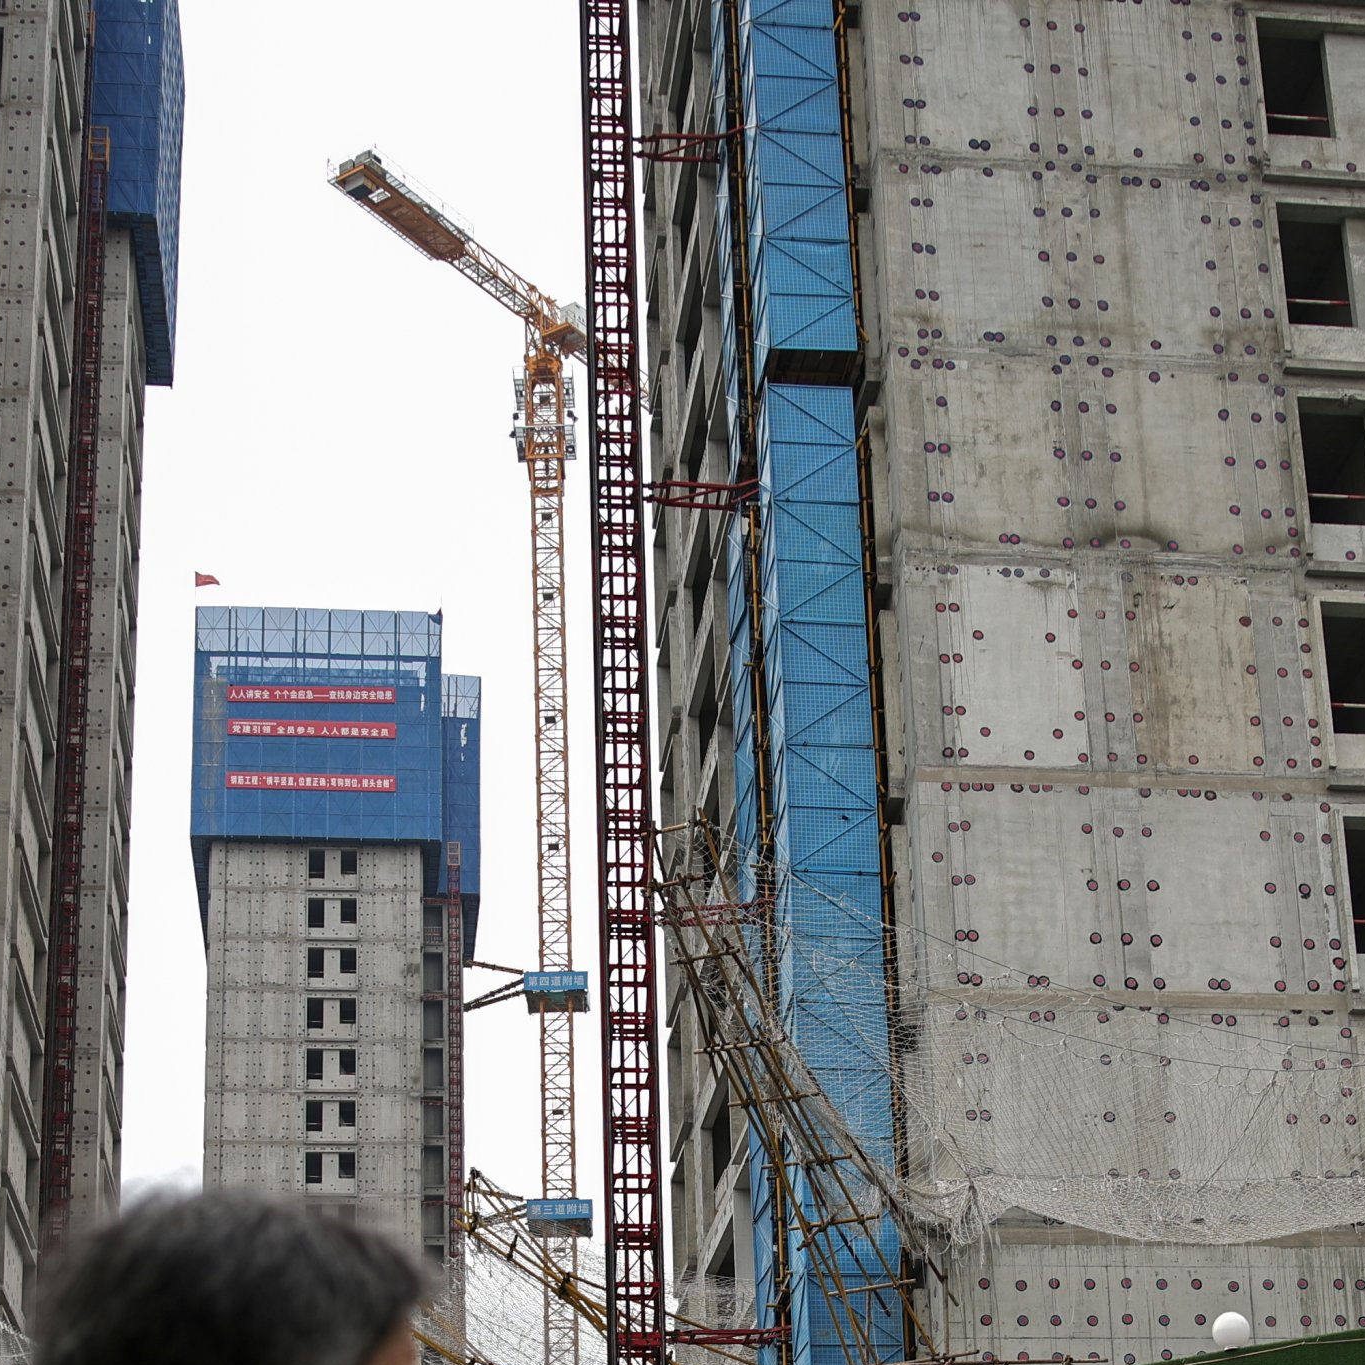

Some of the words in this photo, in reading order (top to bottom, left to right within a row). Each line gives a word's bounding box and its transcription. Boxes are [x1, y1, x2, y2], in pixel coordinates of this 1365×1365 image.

[230, 689, 270, 699] 人人讲安全
[232, 725, 271, 733] 党建引领
[277, 726, 315, 735] 全员参与
[321, 726, 389, 737] 人人都是安全员
[528, 975, 584, 986] 第四道附墙
[531, 1203, 589, 1215] 第三道附墙
